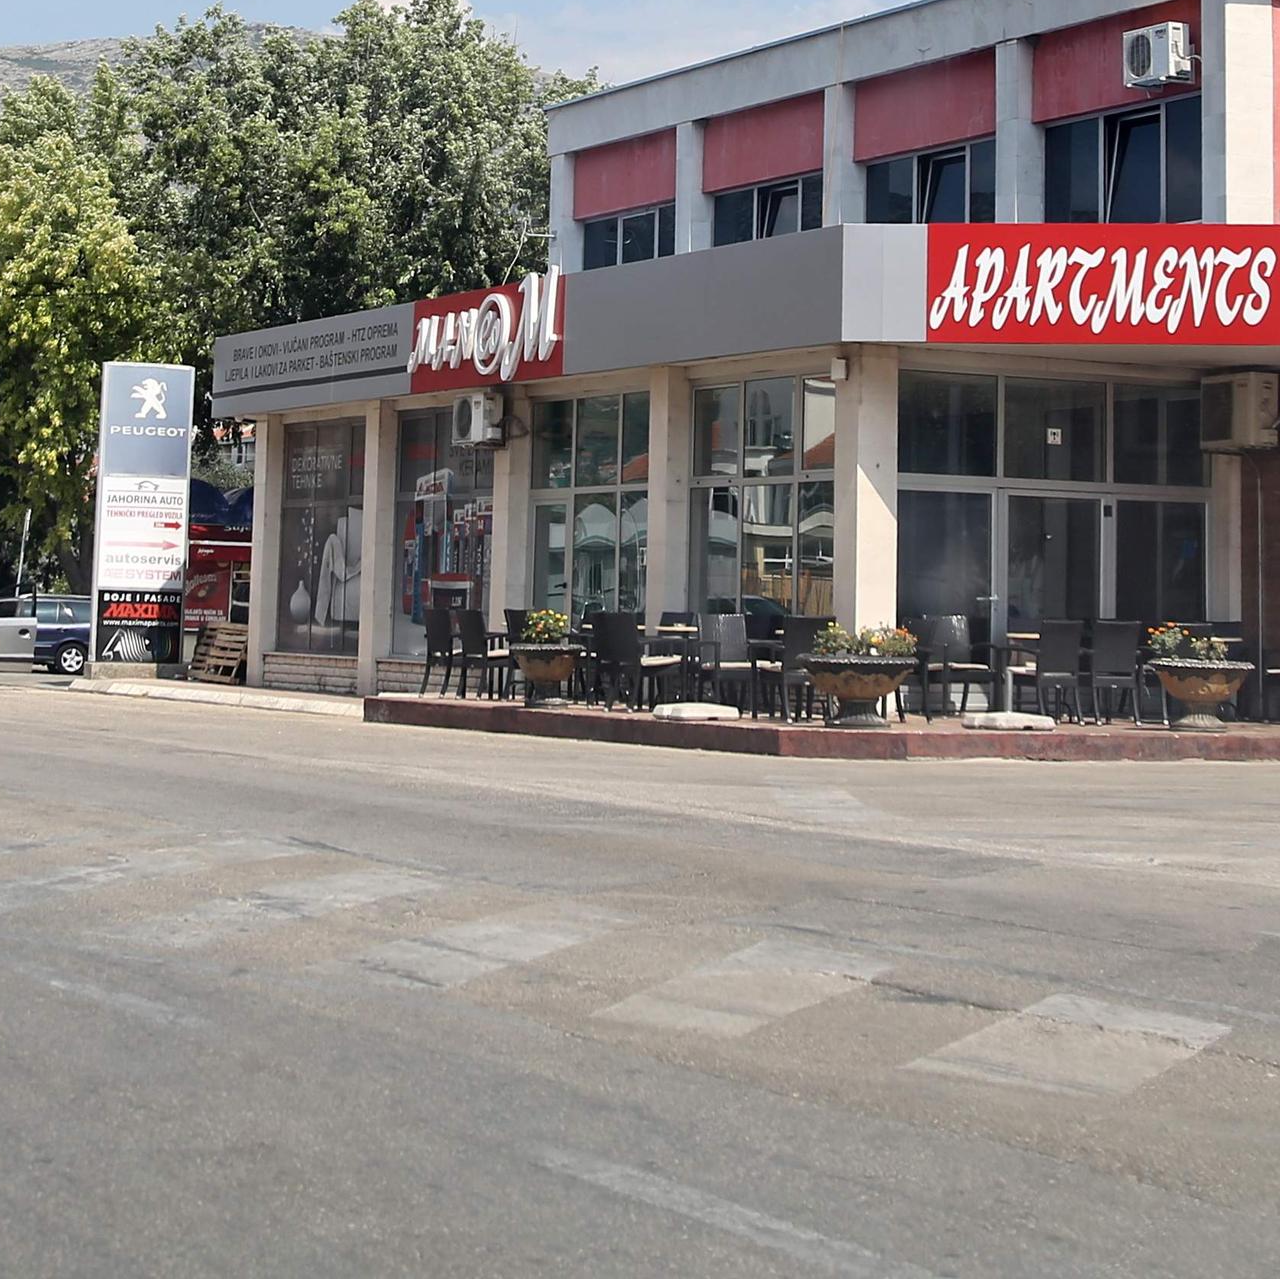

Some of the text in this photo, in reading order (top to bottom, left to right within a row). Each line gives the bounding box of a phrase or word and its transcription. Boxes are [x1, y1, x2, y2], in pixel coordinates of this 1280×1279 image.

[929, 243, 1277, 335] APARTMENTS
[233, 345, 253, 362] BRAVE
[258, 342, 279, 359] OKOVI
[310, 331, 345, 350] PROGRAM
[352, 327, 366, 342] HTZ
[367, 322, 399, 341] OPREMA
[225, 368, 249, 382] LJEPILA
[254, 363, 279, 379] LAKOVI
[279, 361, 288, 375] ZA
[288, 356, 315, 373] PARKET
[320, 349, 359, 369] BAŠTENSKI
[360, 343, 398, 362] PROGRAM
[110, 425, 186, 437] PEUGEOT
[107, 494, 184, 506] JAHORINA AUTO
[107, 509, 136, 518] TEHNIČKI
[137, 509, 163, 519] PREGLED
[164, 510, 183, 519] VOZILA
[105, 553, 182, 566] autoservis
[103, 593, 181, 603] BOJE I FASADE
